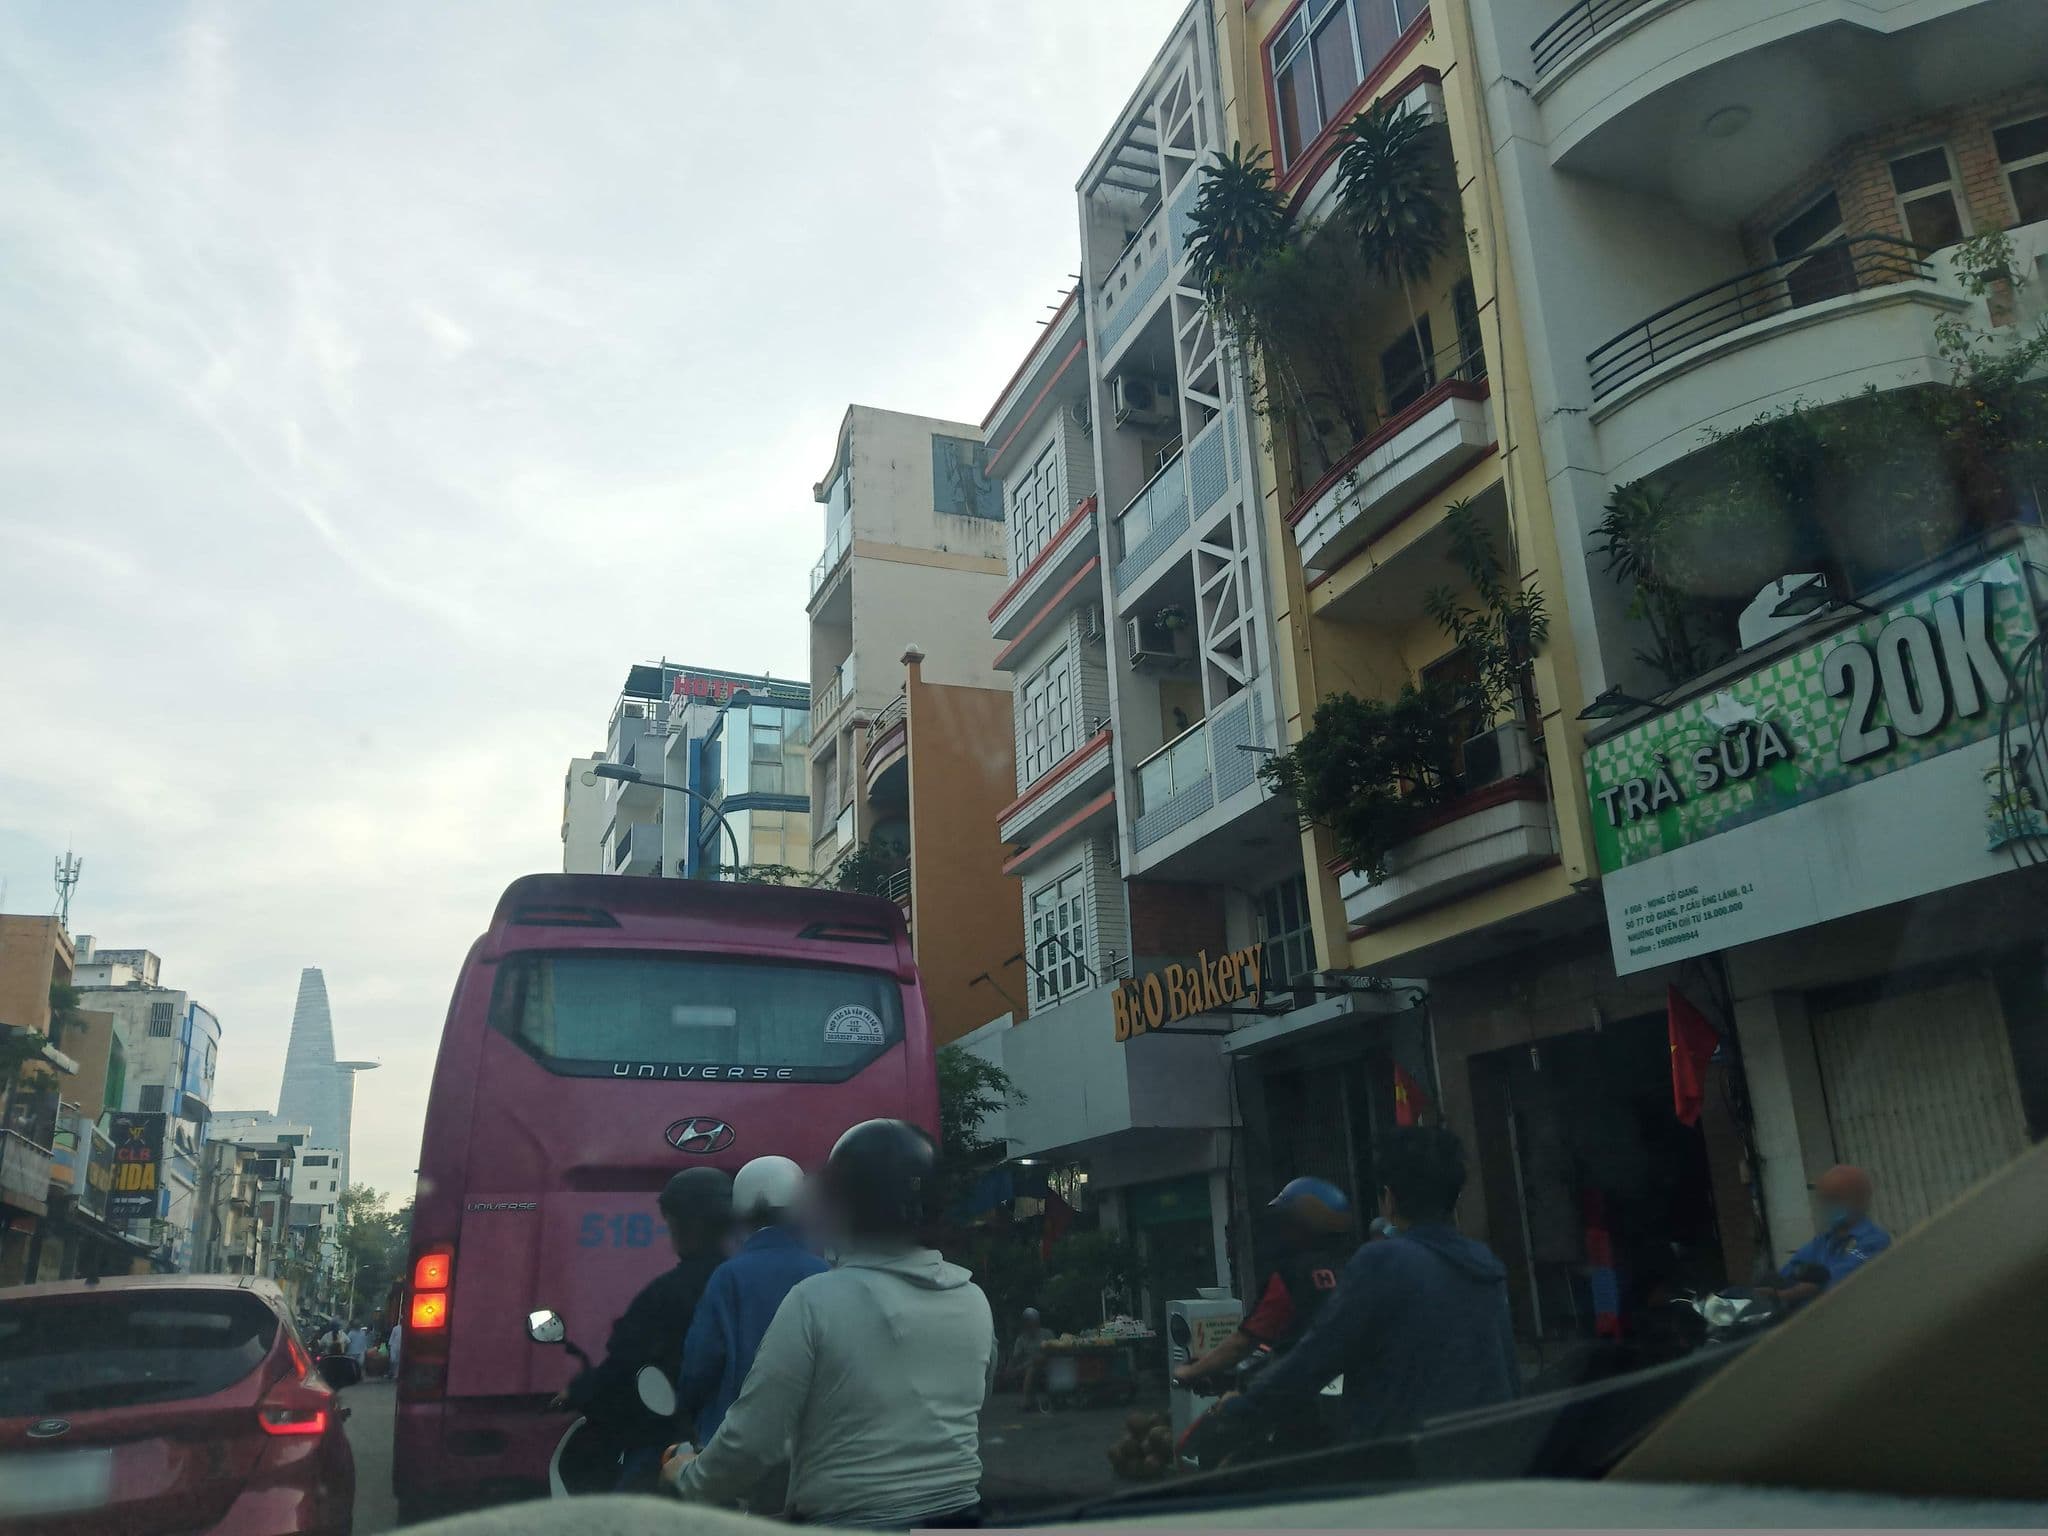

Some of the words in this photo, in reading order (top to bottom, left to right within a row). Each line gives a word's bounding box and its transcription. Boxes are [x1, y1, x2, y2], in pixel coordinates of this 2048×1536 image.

[1597, 753, 1680, 827] TRÀ
[1691, 720, 1789, 790] SỮA
[1823, 581, 2011, 764] 20K
[1677, 886, 1699, 898] GIANG
[1741, 883, 1754, 895] Q.1
[1655, 919, 1678, 935] QUYỀN
[1164, 943, 1263, 1022] Bakery
[613, 1063, 793, 1080] UNIVERSE
[118, 1148, 151, 1161] CLB
[467, 1201, 537, 1212] UNIVERSE
